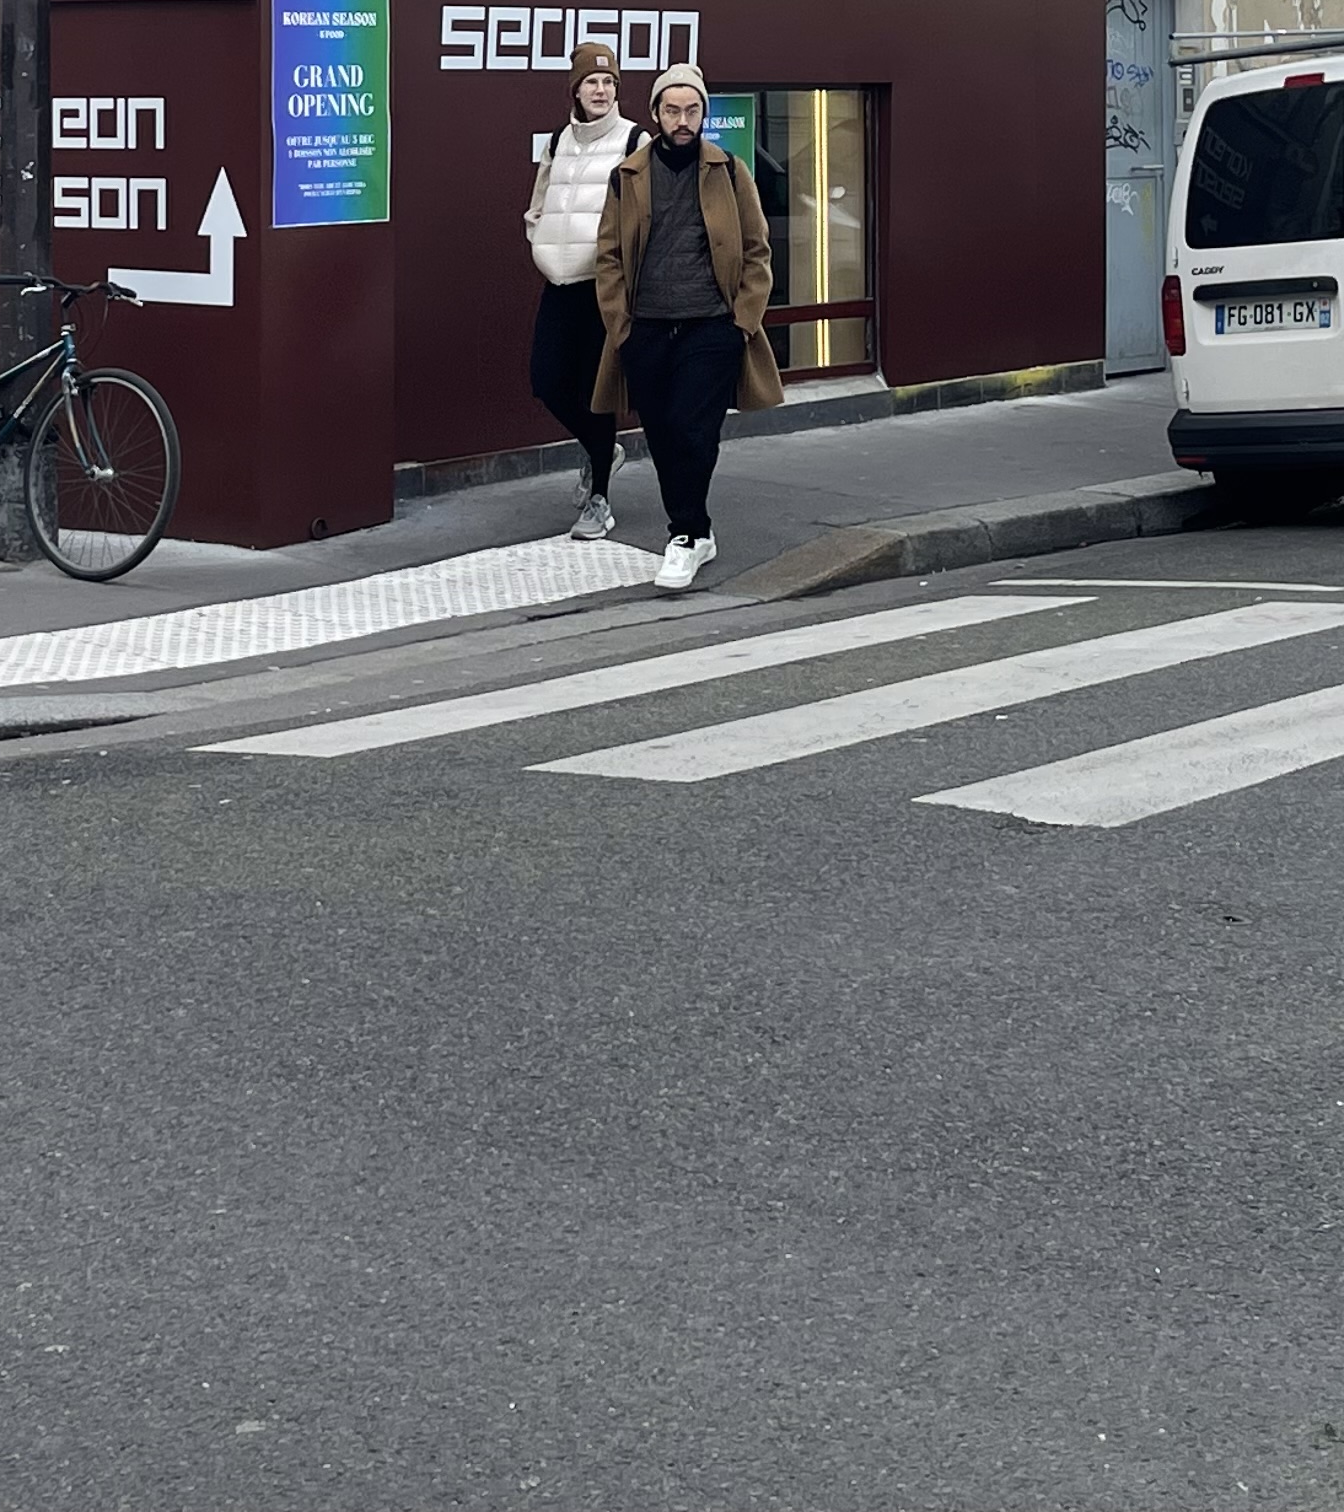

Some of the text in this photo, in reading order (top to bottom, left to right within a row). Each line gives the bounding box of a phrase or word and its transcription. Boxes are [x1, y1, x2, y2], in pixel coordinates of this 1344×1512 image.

[283, 11, 377, 27] KOREAN SEASON
[293, 64, 364, 88] GRAND
[287, 92, 375, 118] OPENING
[710, 116, 746, 129] SEASON
